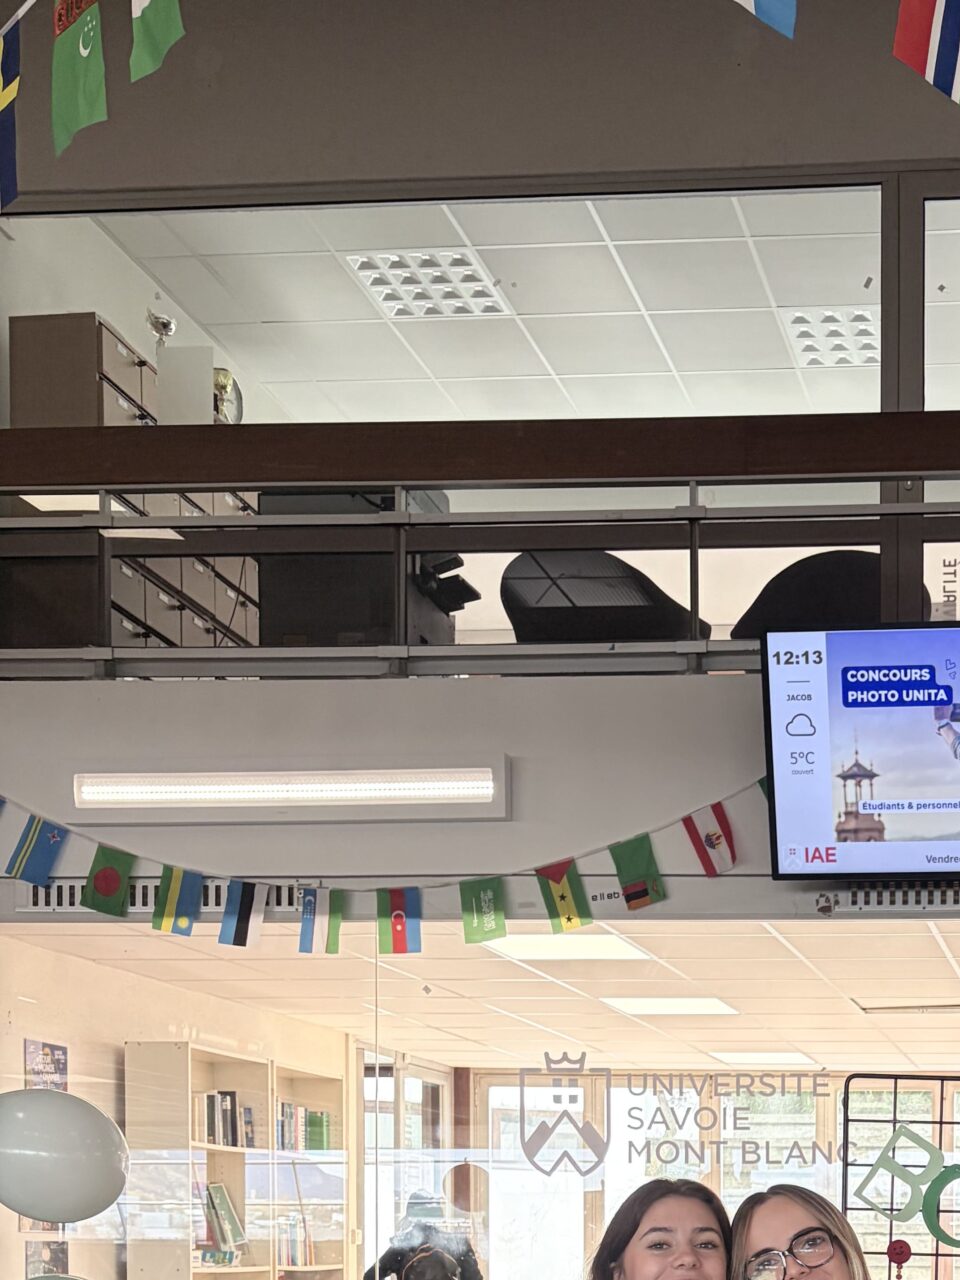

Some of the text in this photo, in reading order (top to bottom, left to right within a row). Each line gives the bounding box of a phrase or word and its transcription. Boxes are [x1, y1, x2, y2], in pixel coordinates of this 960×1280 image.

[772, 650, 823, 665] 12:13
[847, 669, 930, 682] CONCOURS
[786, 694, 812, 702] JACOB
[848, 689, 947, 702] PHOTO UNITA
[790, 751, 815, 765] 5°C
[862, 801, 905, 810] Étudiants
[908, 802, 914, 810] &
[805, 847, 837, 863] IAE
[626, 1068, 831, 1097] UNIVERSITÉ
[626, 1106, 750, 1131] SAVOIE
[628, 1140, 858, 1164] MONT BLANC
